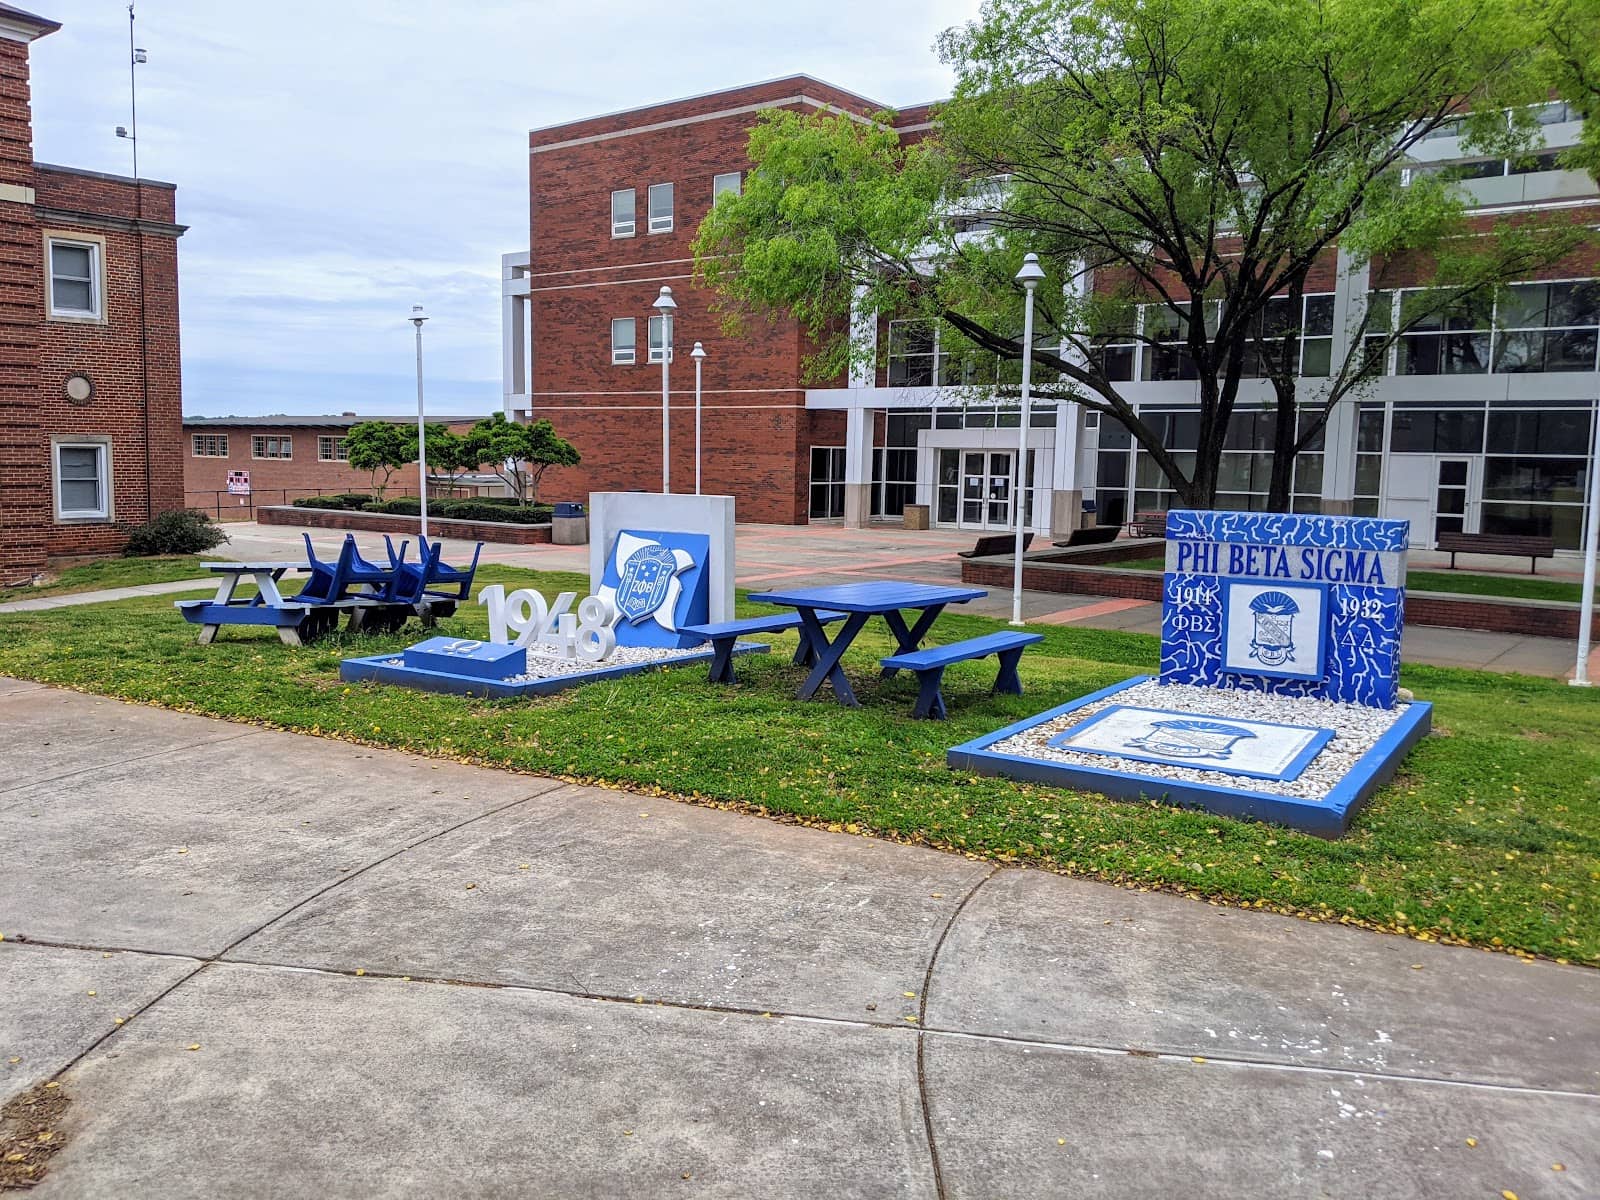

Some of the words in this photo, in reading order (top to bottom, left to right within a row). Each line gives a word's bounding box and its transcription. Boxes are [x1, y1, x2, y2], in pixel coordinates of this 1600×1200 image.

[1177, 542, 1220, 574] PHI
[1229, 544, 1292, 578] BETA
[1301, 549, 1386, 585] SIGMA
[1176, 586, 1212, 605] 1914
[1340, 598, 1385, 619] 1932
[478, 584, 616, 662] 1948
